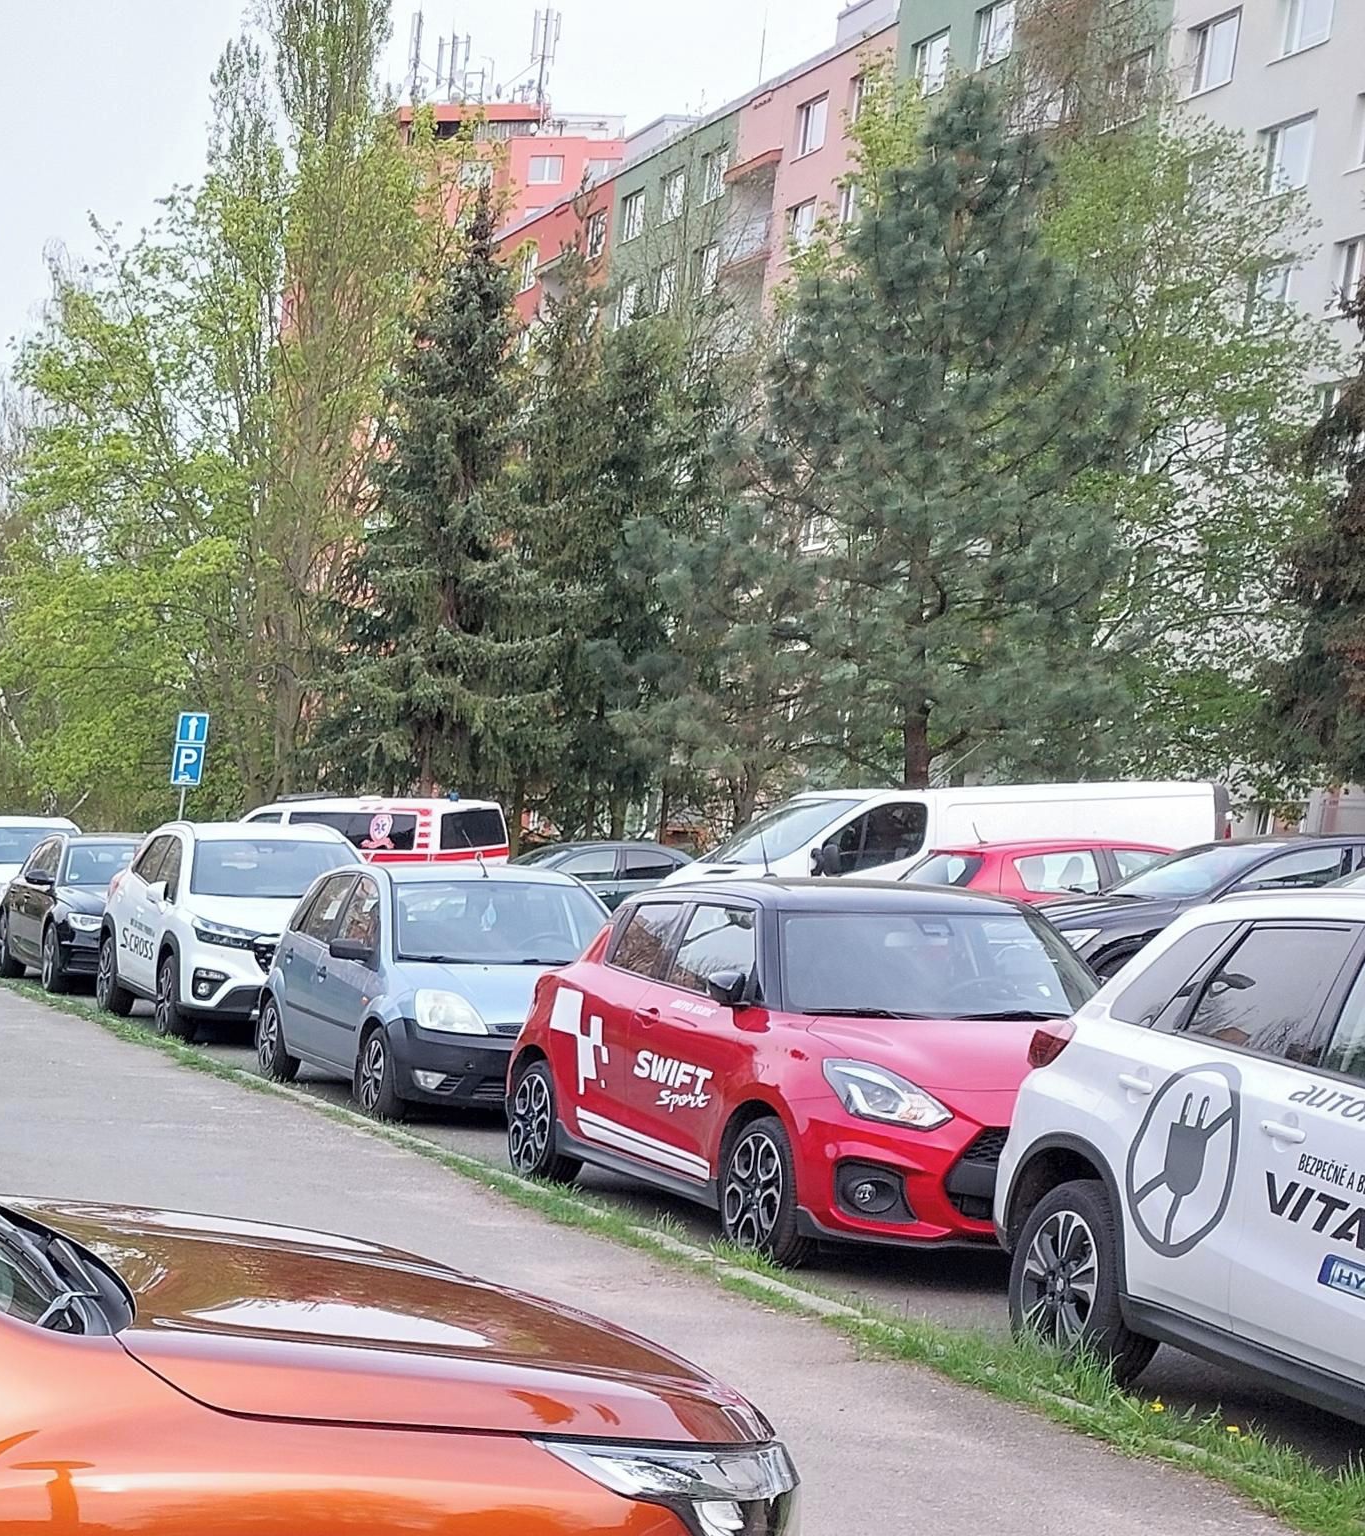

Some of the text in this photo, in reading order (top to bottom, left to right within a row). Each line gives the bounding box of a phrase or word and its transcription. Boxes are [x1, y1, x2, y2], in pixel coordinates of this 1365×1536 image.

[178, 748, 198, 772] P
[633, 1050, 714, 1095] SWIFT
[655, 1089, 712, 1113] Sport
[1298, 1153, 1349, 1187] BEZPEČNĚ
[1346, 1171, 1356, 1191] A
